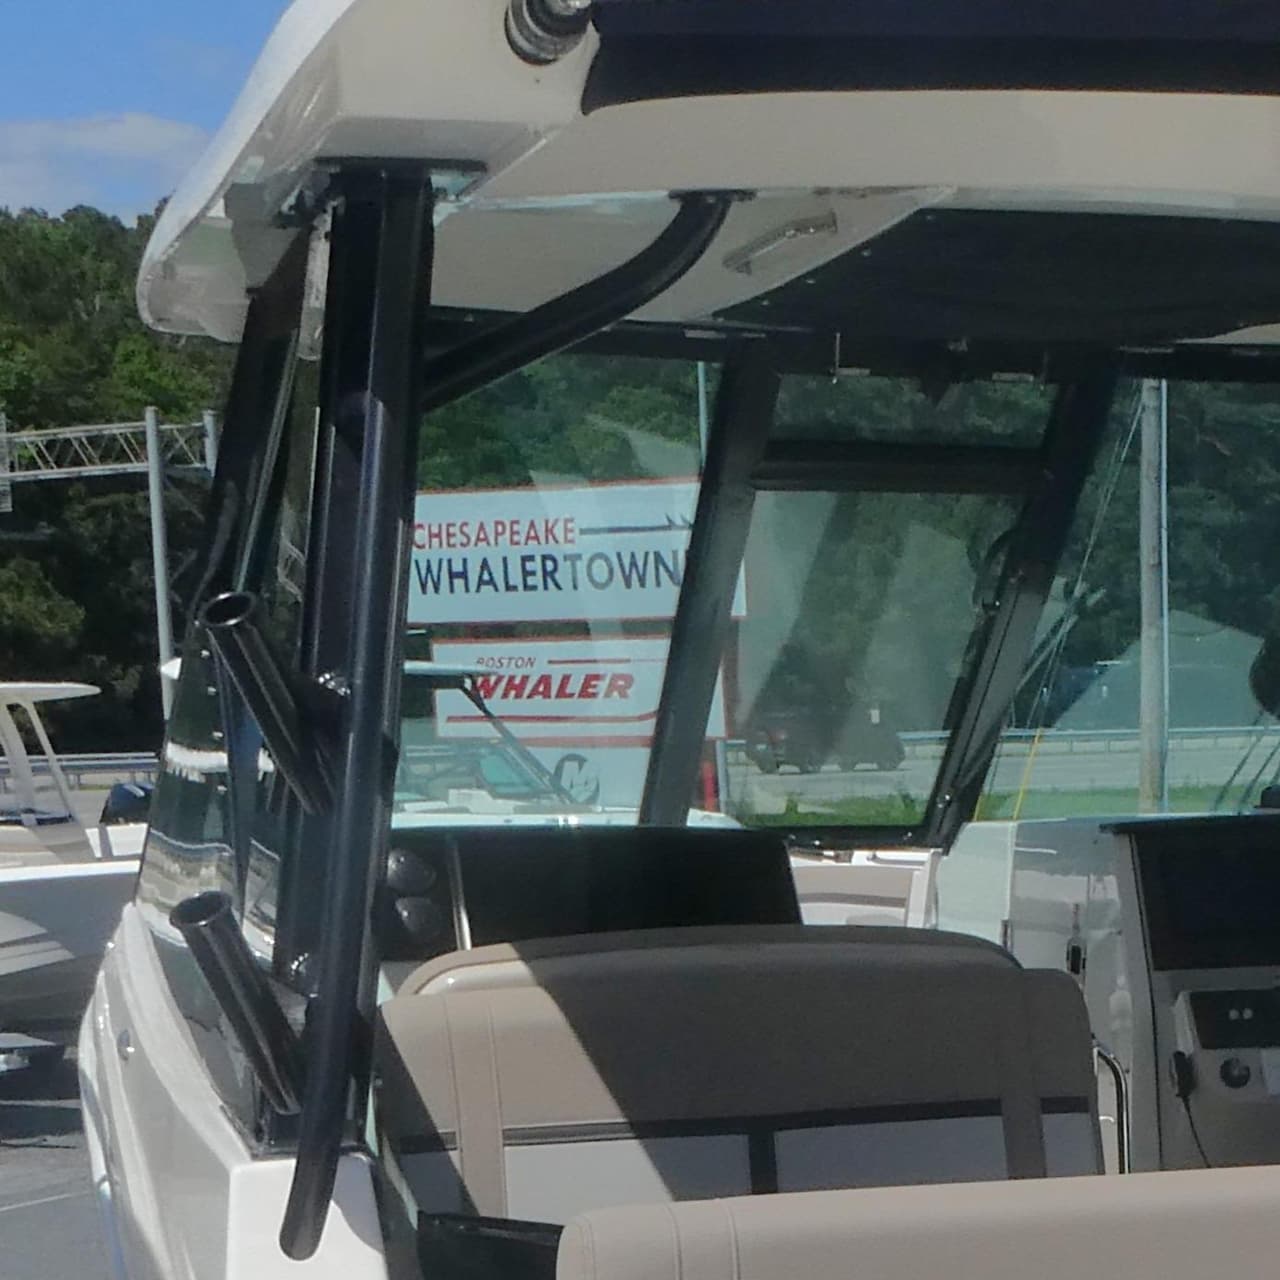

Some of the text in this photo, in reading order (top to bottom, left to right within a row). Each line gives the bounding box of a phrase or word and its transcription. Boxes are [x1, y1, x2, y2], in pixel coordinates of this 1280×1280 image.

[412, 517, 576, 550] CHESAPEAKE
[414, 550, 681, 595] WHALERTOWN
[475, 673, 634, 699] WHALER
